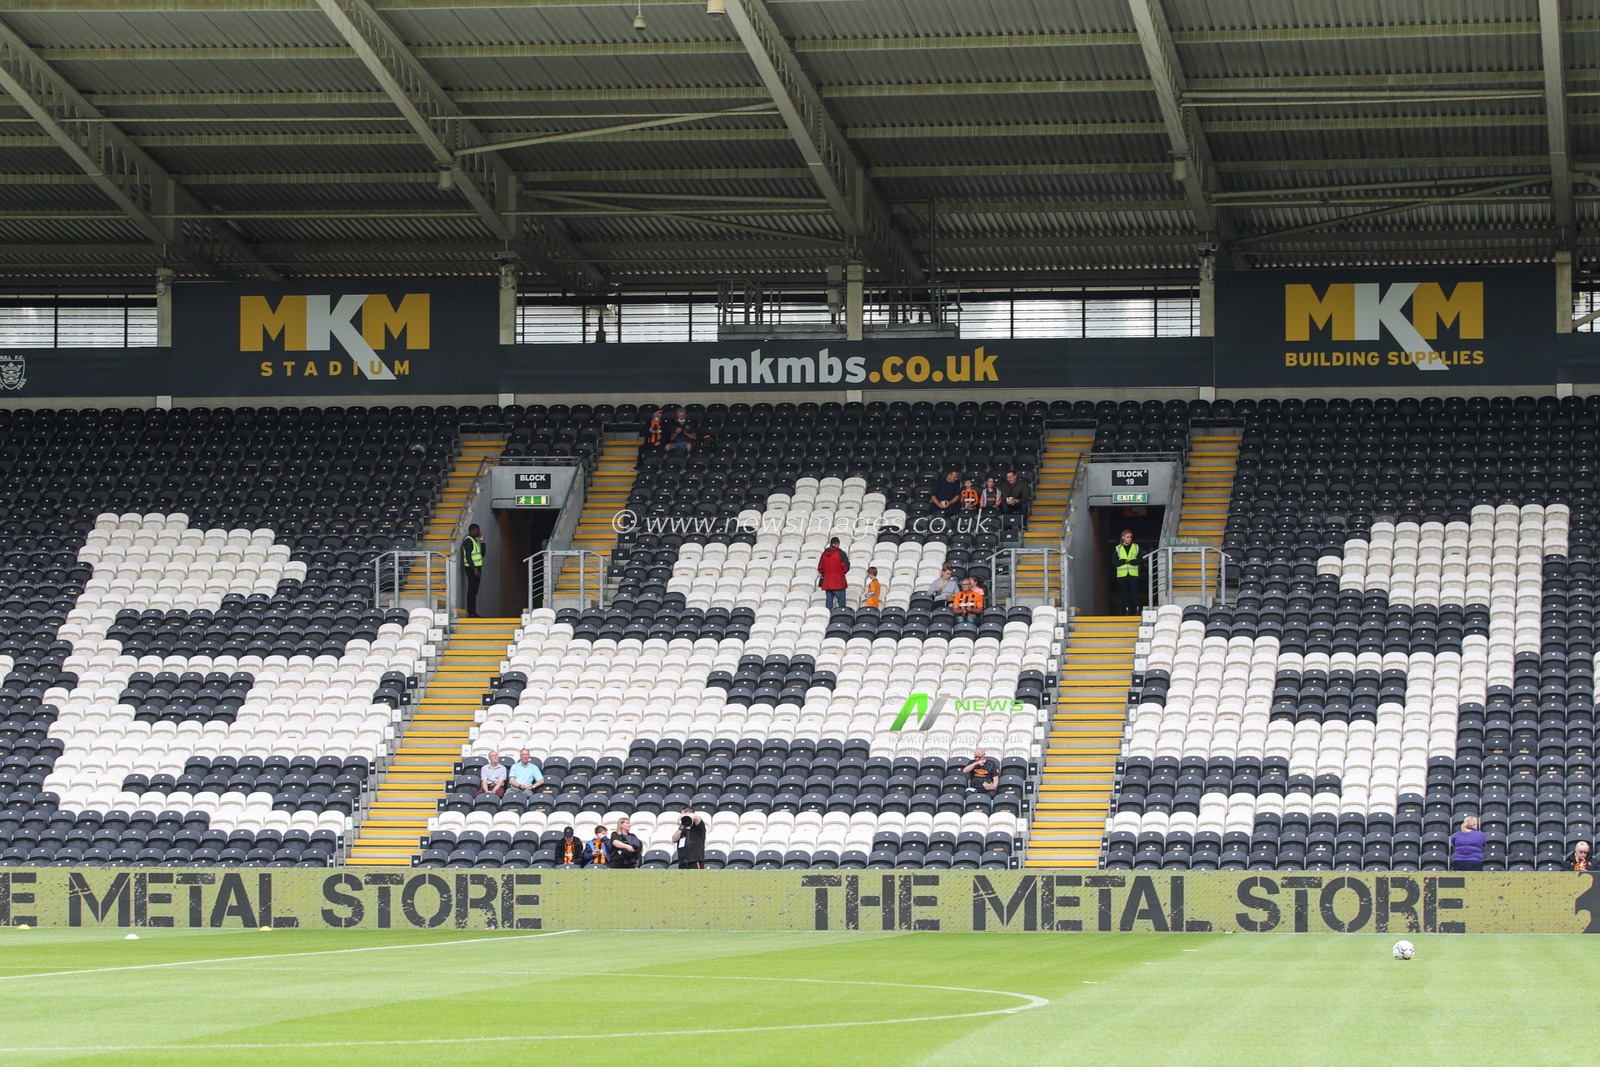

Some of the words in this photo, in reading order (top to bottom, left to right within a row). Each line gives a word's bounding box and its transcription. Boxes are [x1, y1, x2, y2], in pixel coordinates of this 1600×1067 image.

[240, 293, 430, 380] MKM
[1285, 282, 1484, 371] MKM
[260, 359, 410, 377] STADIUM
[709, 345, 999, 385] mkmbs.co.uk
[1285, 351, 1380, 367] BUILDING
[1387, 350, 1484, 366] SUPPLIES
[1116, 470, 1143, 478] BLOCK
[0, 873, 37, 926] E
[69, 873, 299, 928] METAL
[320, 873, 542, 929] STORE
[800, 875, 940, 931] THE
[972, 875, 1213, 932] METAL
[1235, 876, 1466, 933] STORE
